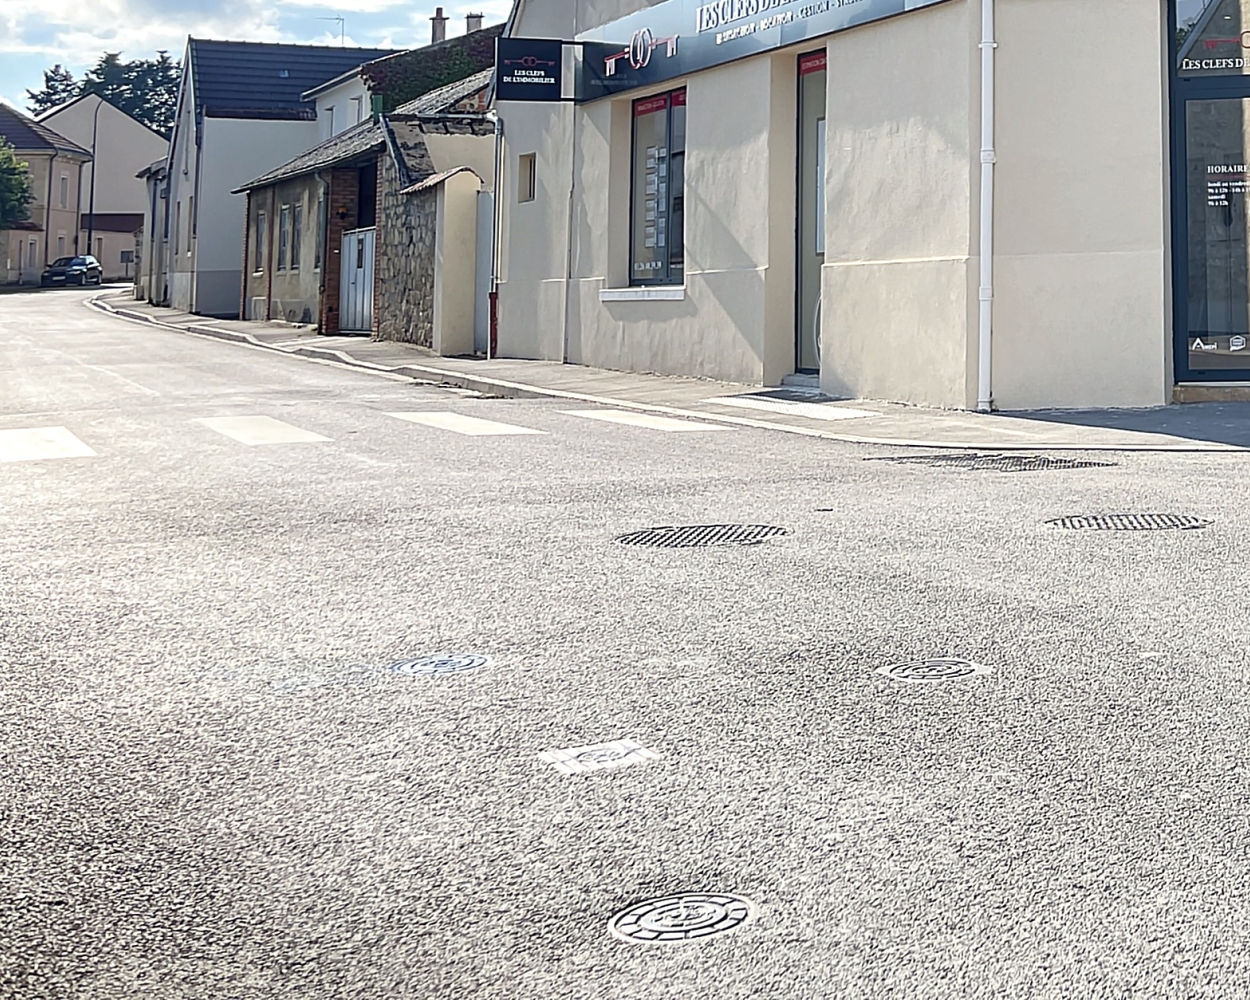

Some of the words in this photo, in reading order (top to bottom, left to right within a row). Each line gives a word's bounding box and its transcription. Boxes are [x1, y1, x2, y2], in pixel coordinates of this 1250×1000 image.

[1182, 58, 1200, 70] LES
[1201, 58, 1234, 69] CLEFS
[1235, 57, 1250, 68] DE
